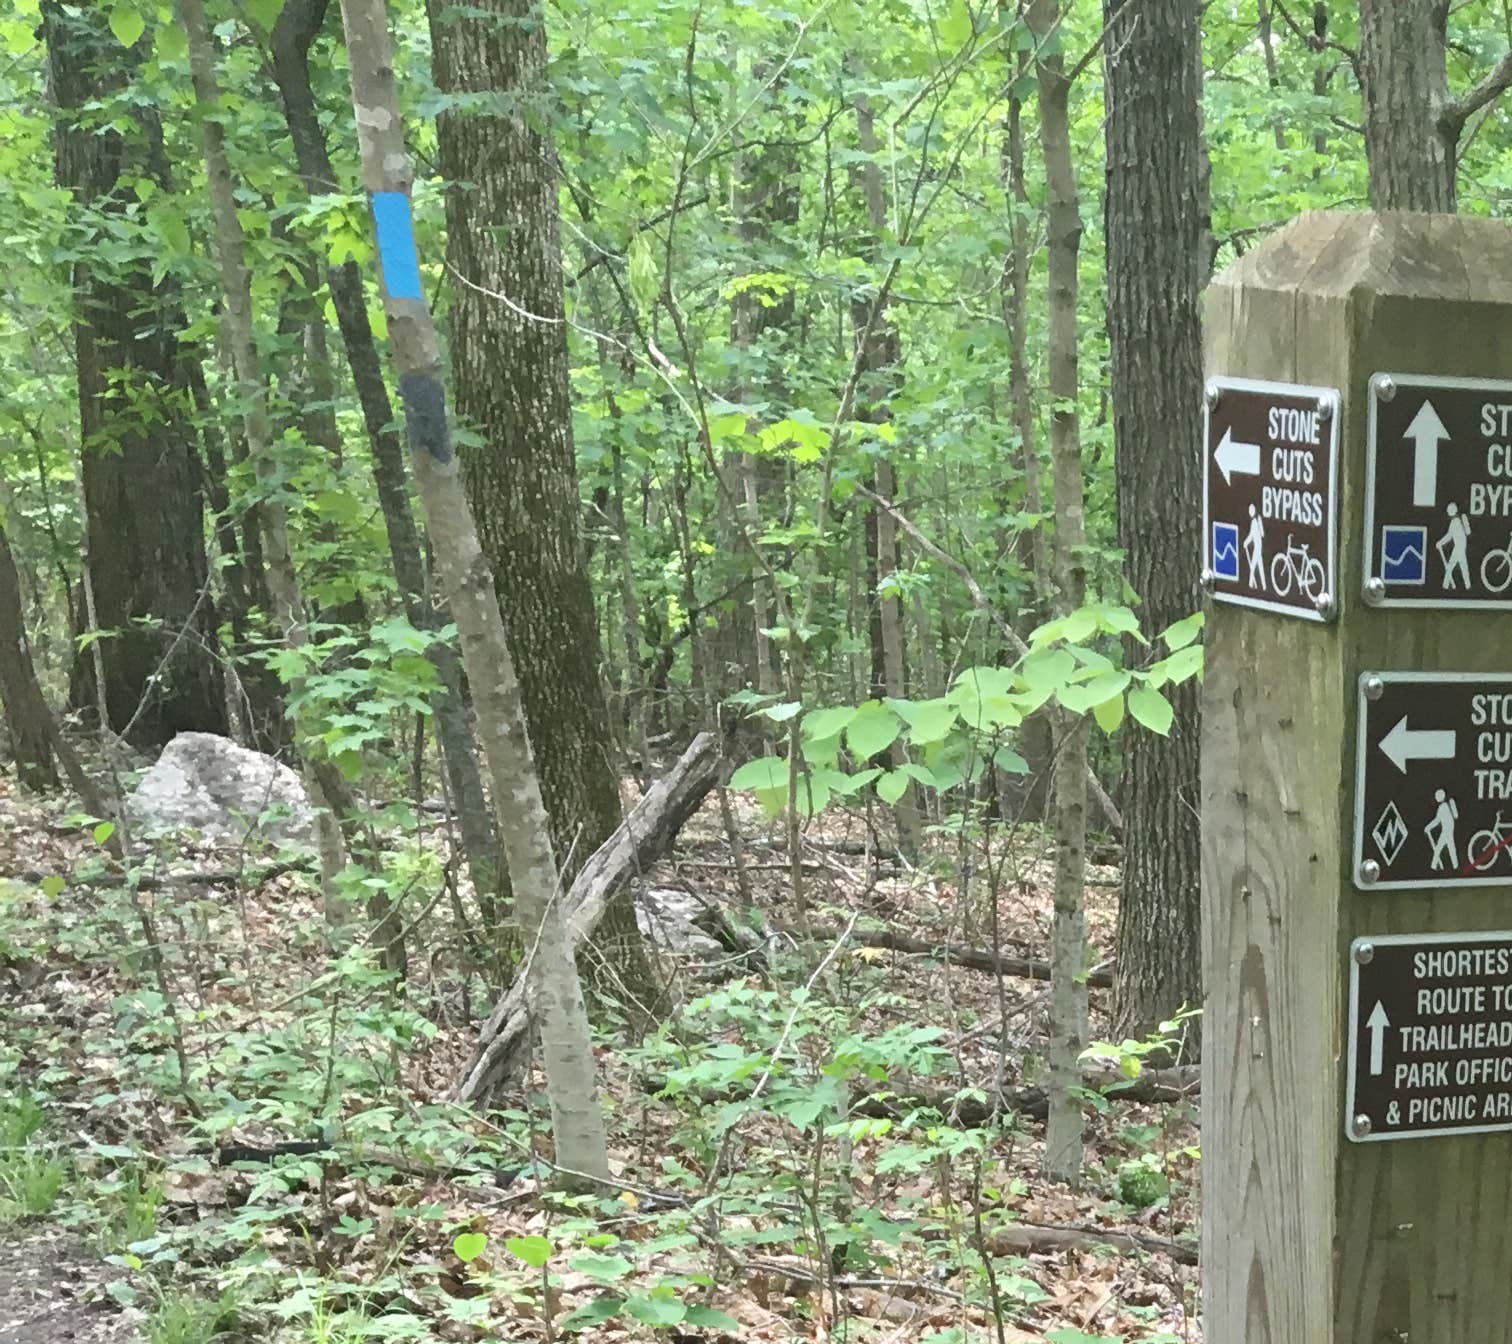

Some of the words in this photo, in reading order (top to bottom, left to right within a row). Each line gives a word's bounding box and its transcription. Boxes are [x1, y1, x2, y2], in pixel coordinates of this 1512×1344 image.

[1268, 406, 1320, 444] STONE
[1272, 447, 1314, 484] CUTS
[1261, 486, 1323, 527] BYPASS
[1417, 986, 1486, 1015] ROUTE
[1394, 1060, 1449, 1089] PARK
[1385, 1100, 1401, 1125] &
[1408, 1094, 1477, 1124] PICNIC
